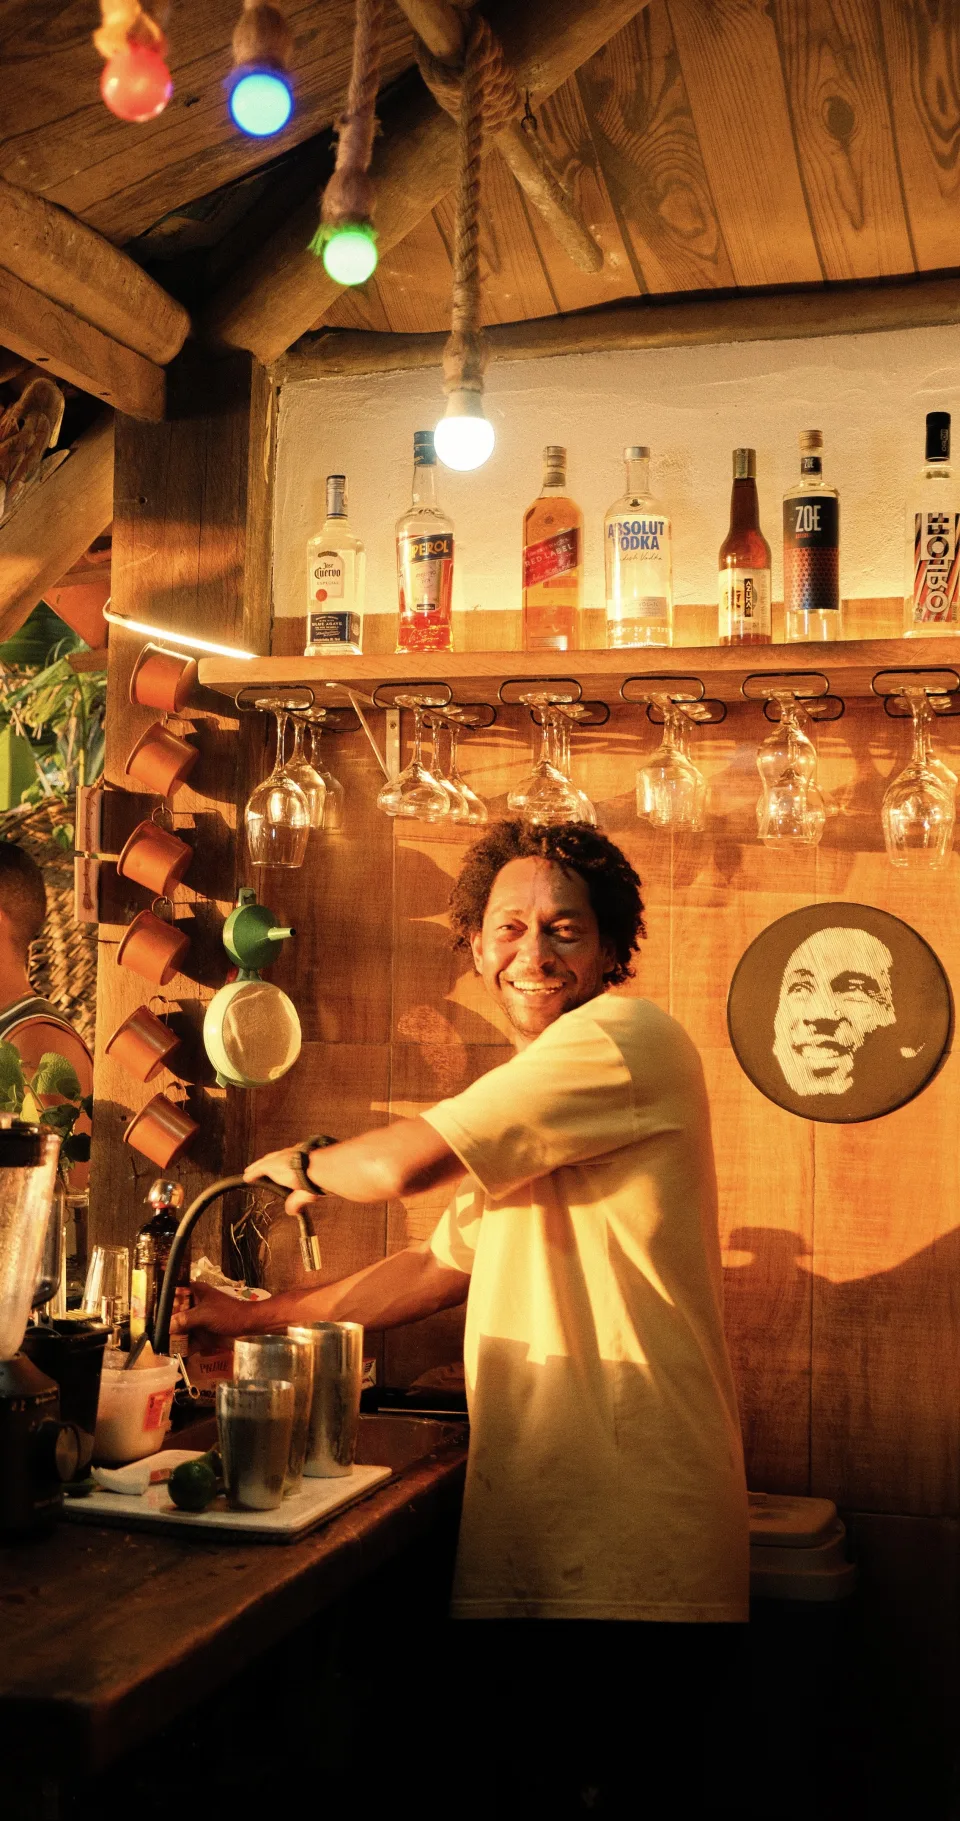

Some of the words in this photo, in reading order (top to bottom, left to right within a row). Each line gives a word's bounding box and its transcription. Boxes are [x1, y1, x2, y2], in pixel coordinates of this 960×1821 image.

[804, 458, 815, 468] ZOE
[795, 505, 822, 533] ZOE
[608, 520, 665, 538] ABSOLUT
[410, 540, 449, 558] PEROL
[525, 555, 543, 567] RED
[544, 543, 575, 559] LABEL
[314, 566, 341, 580] Cuervo
